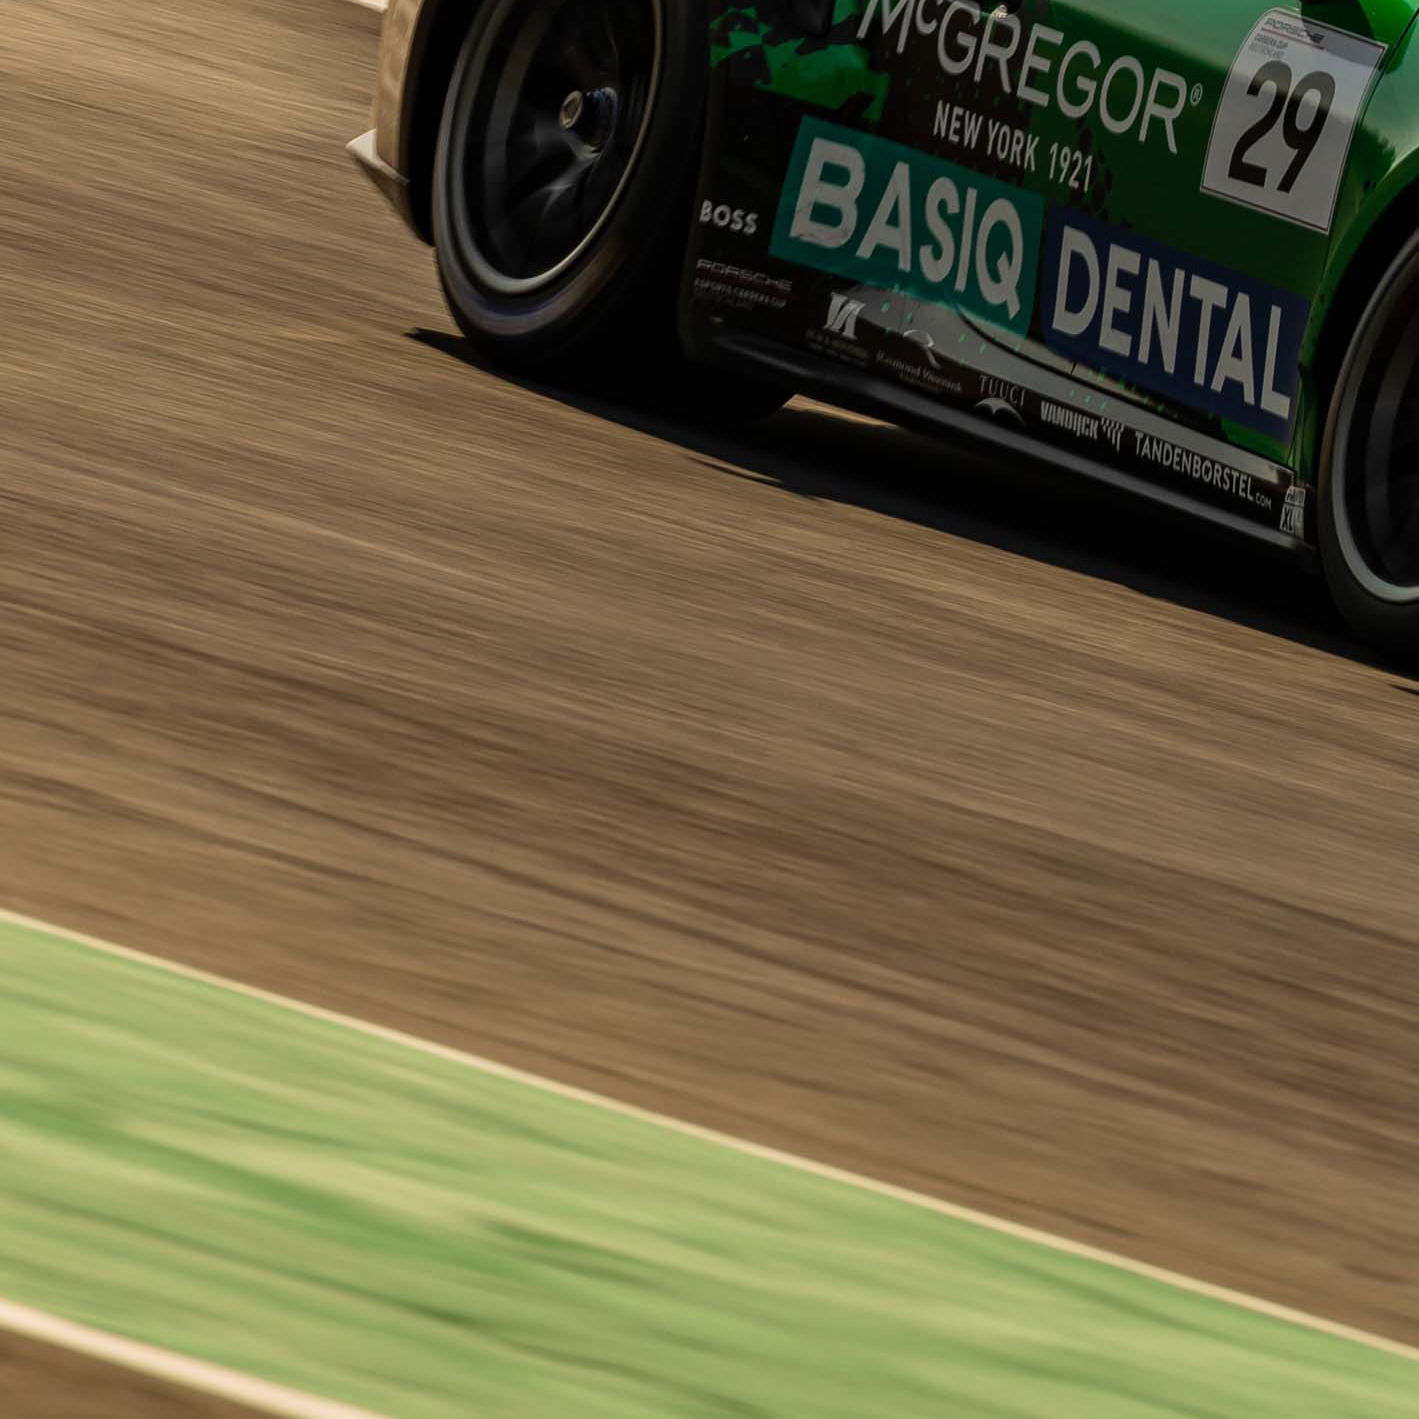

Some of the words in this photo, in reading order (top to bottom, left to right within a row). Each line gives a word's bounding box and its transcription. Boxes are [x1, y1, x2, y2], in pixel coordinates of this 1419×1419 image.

[932, 100, 985, 151] NEW
[985, 113, 1039, 174] YORK
[1048, 142, 1094, 194] 1921
[1228, 59, 1336, 194] 29
[700, 199, 760, 235] BOSS
[788, 136, 1025, 321] BASIQ
[1051, 225, 1290, 421] DENTAL
